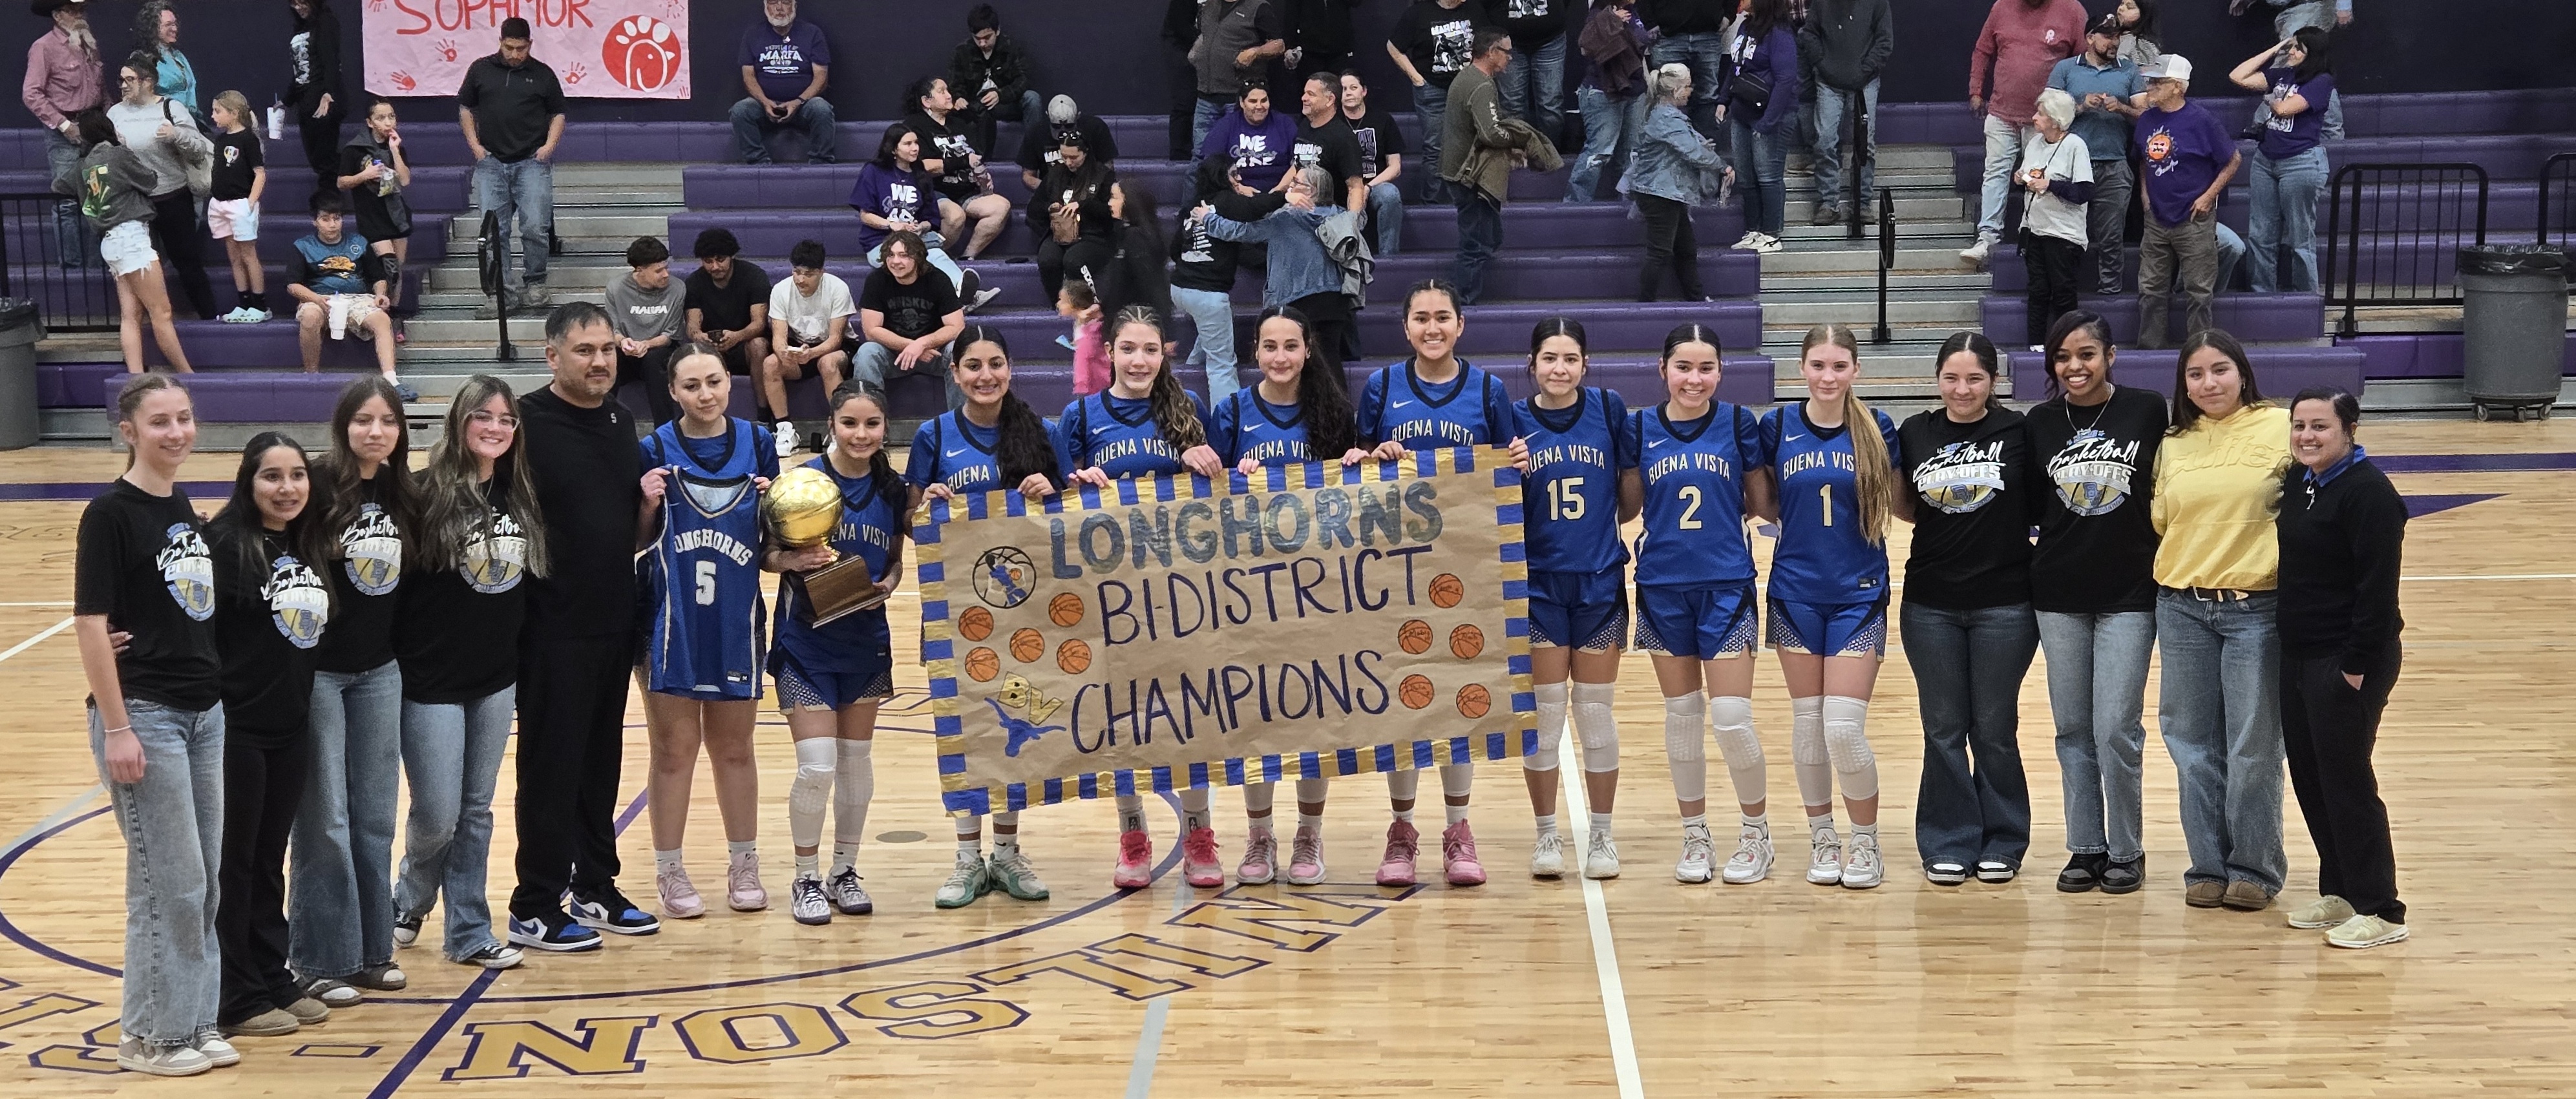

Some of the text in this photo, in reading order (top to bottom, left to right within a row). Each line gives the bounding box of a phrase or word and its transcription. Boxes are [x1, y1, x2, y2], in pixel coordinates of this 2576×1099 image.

[759, 50, 803, 62] MARFA
[1239, 133, 1267, 152] WE
[891, 183, 918, 204] WE
[1392, 419, 1474, 446] BUENA VISTA
[1094, 438, 1137, 468] BUENA
[1291, 439, 1313, 461] VIS
[1568, 443, 1605, 470] VISTA
[1784, 450, 1854, 481] BUENA VIS
[2045, 438, 2140, 477] Basketball
[947, 465, 991, 491] BUENA
[1649, 452, 1731, 485] BUENA VISTA
[1547, 477, 1585, 521] 15
[1678, 485, 1702, 530] 2
[1820, 484, 1832, 527] 1
[862, 523, 890, 554] VISTA
[1049, 479, 1444, 580] LONGHORNS
[695, 560, 717, 606] 5
[1098, 545, 1433, 647] BI-DISTRICT
[1071, 649, 1390, 754] CHAMPIONS
